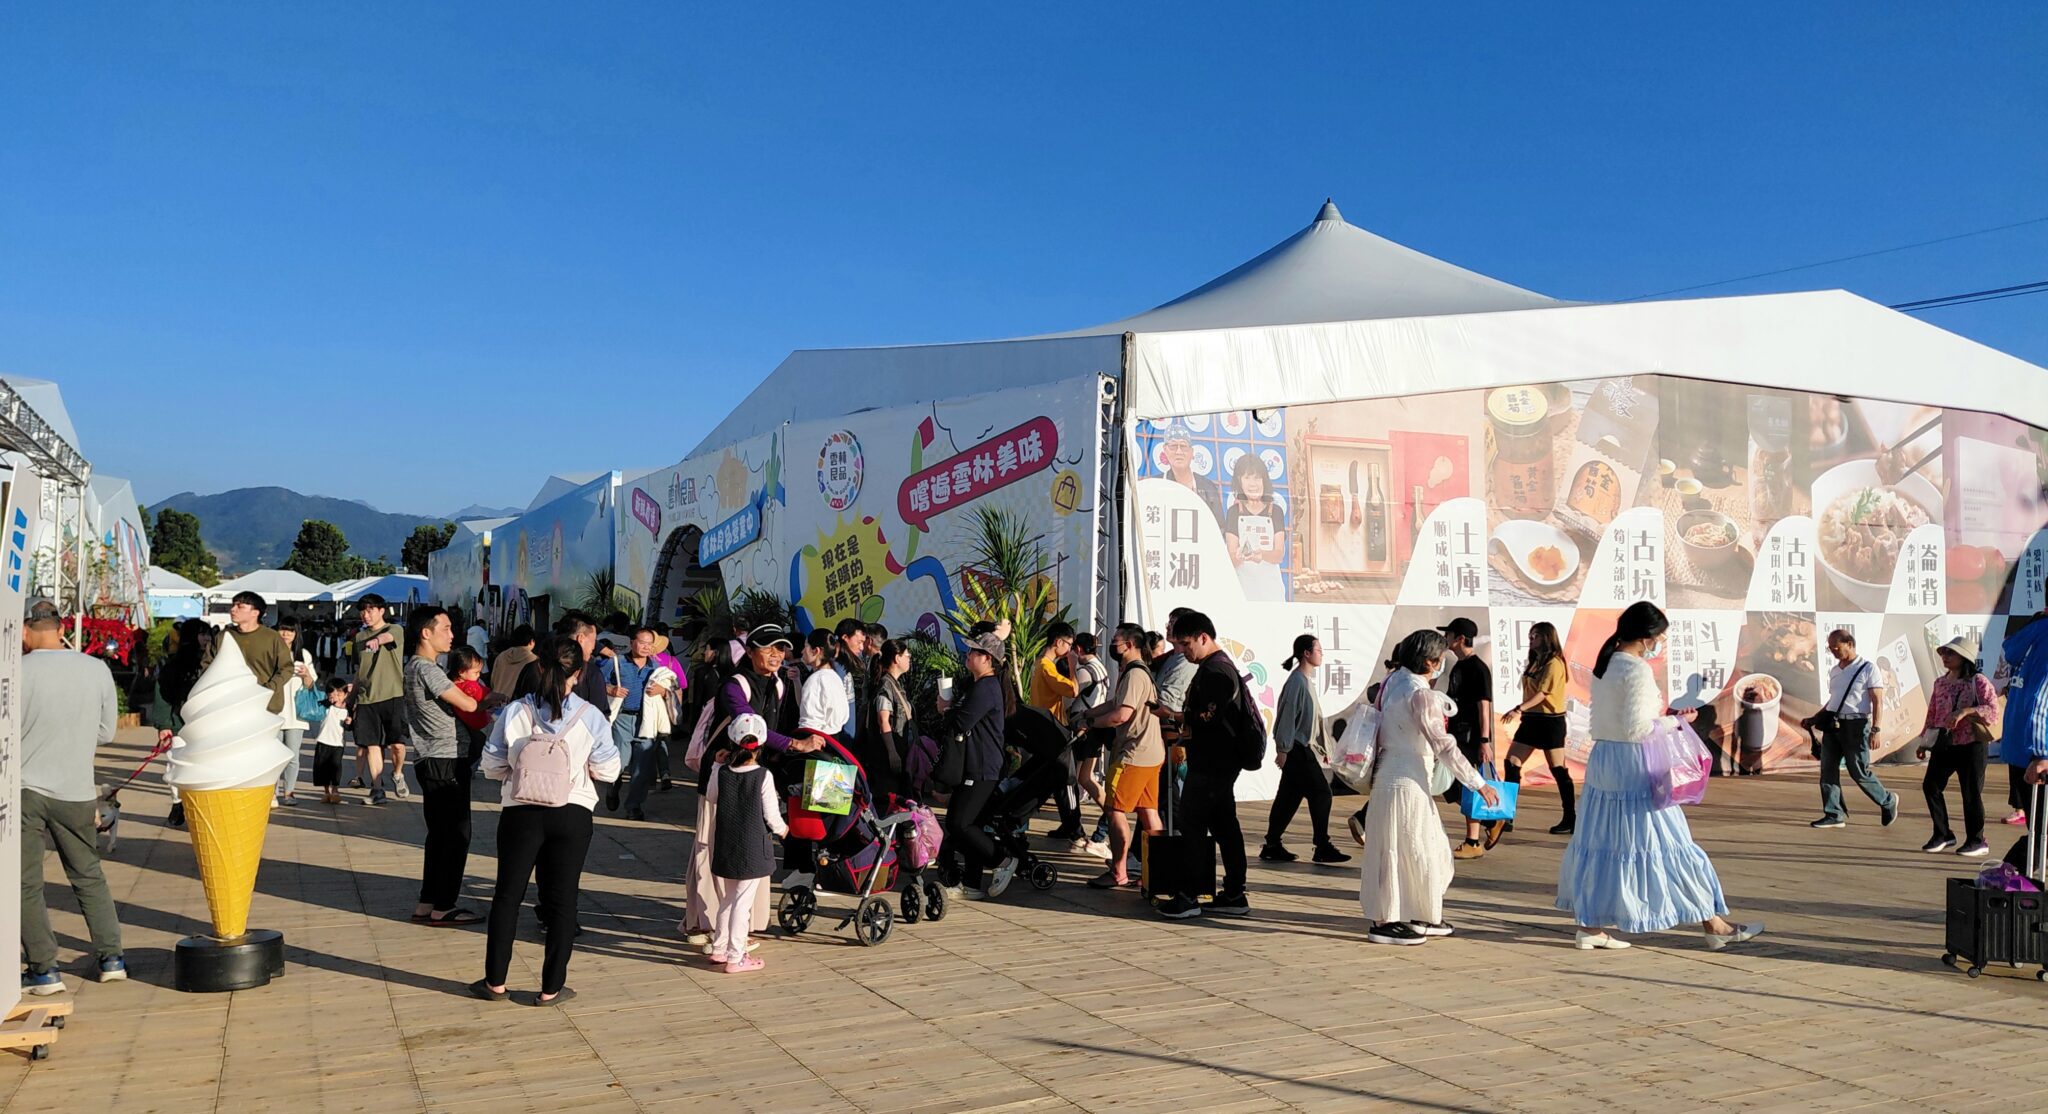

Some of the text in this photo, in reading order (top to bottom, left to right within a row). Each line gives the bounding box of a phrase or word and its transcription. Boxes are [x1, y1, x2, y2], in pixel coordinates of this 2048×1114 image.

[909, 429, 1044, 513] 嚐遍雲林美味
[821, 534, 861, 570] 現在是
[825, 558, 863, 594] 採購的
[1169, 508, 1200, 590] 口湖
[1455, 522, 1482, 597] 土庫
[1632, 530, 1659, 600] 古坑
[1787, 537, 1808, 604] 古坑
[1921, 544, 1938, 606] 崙背
[1323, 616, 1352, 695] 土庫
[1701, 621, 1726, 690] 斗南
